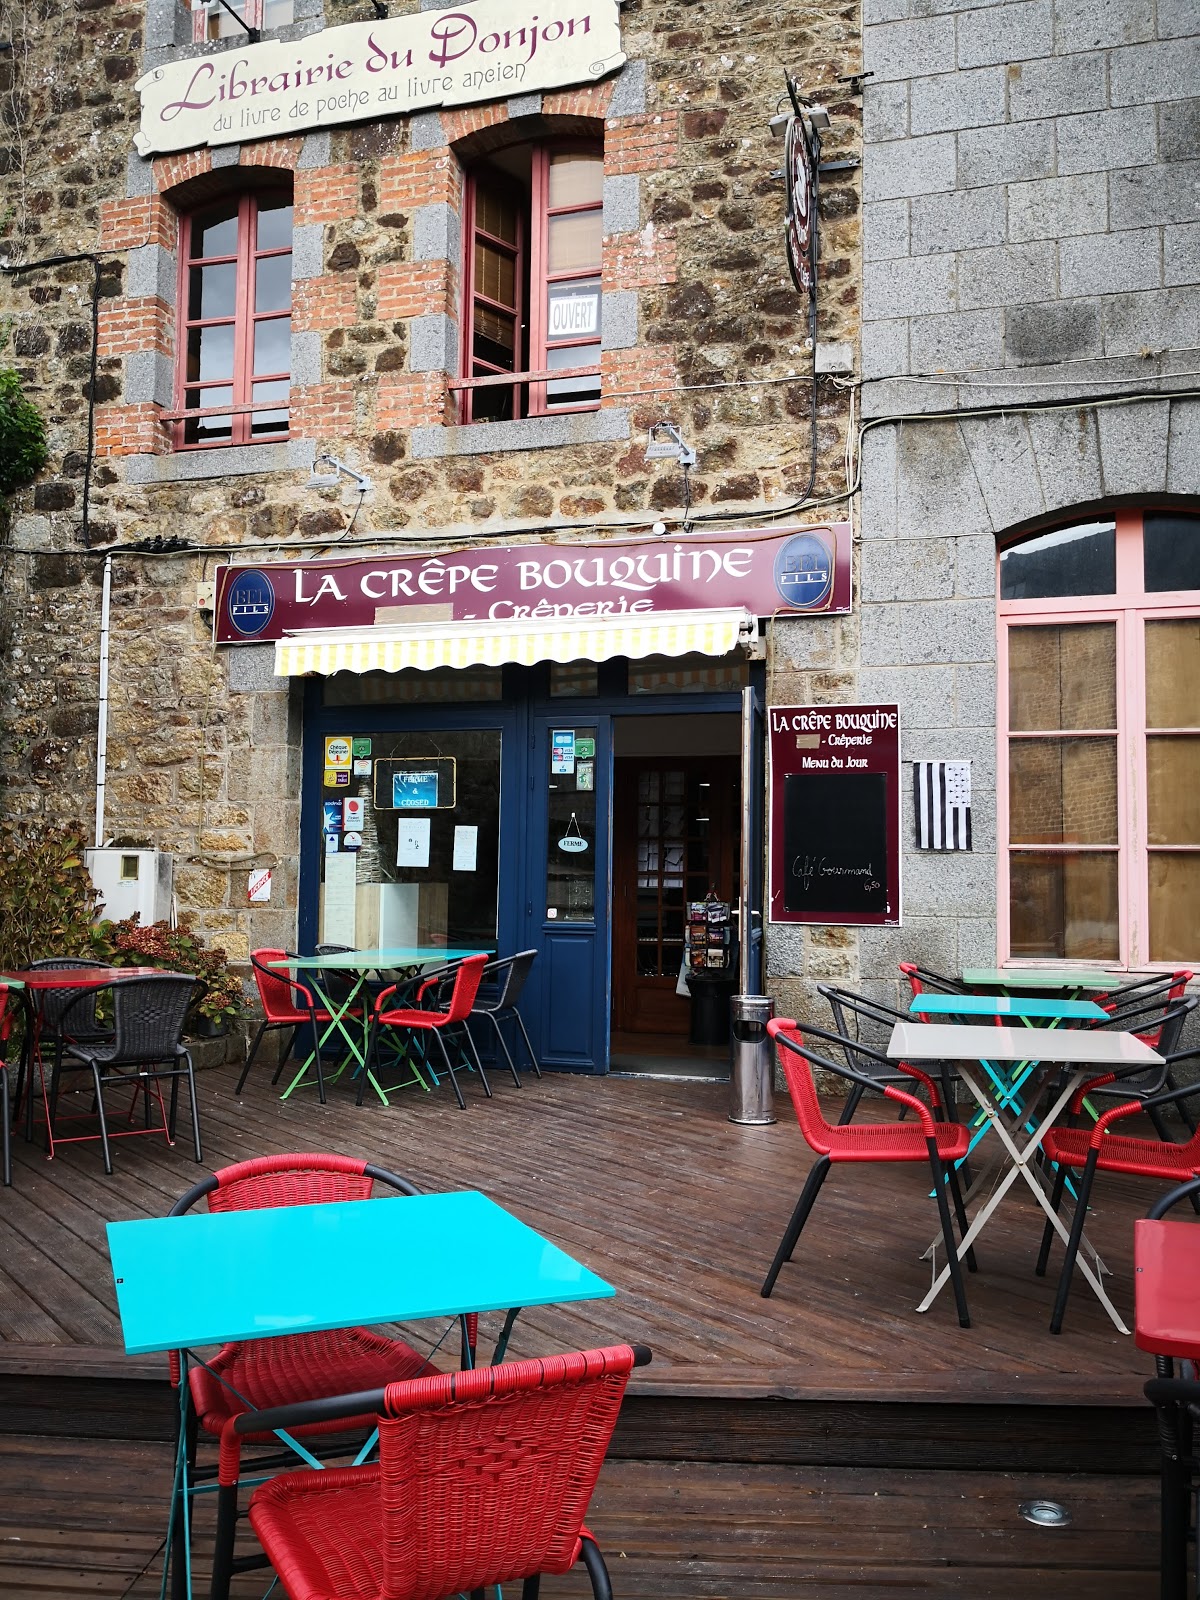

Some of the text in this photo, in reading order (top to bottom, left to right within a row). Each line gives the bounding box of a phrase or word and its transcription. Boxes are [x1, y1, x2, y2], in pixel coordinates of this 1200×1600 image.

[159, 12, 592, 122] Librairie du Donjon
[212, 61, 527, 132] du livre de poche au livre ancien
[553, 301, 594, 330] OUVERT
[293, 568, 347, 606] LA
[359, 559, 498, 598] CRÊPE
[781, 573, 827, 583] PILS
[773, 712, 790, 733] LA
[792, 710, 831, 732] CRÊPE
[828, 733, 872, 749] Crêperie
[802, 755, 869, 769] Menu du Jour
[792, 855, 873, 892] Café Gourmand
